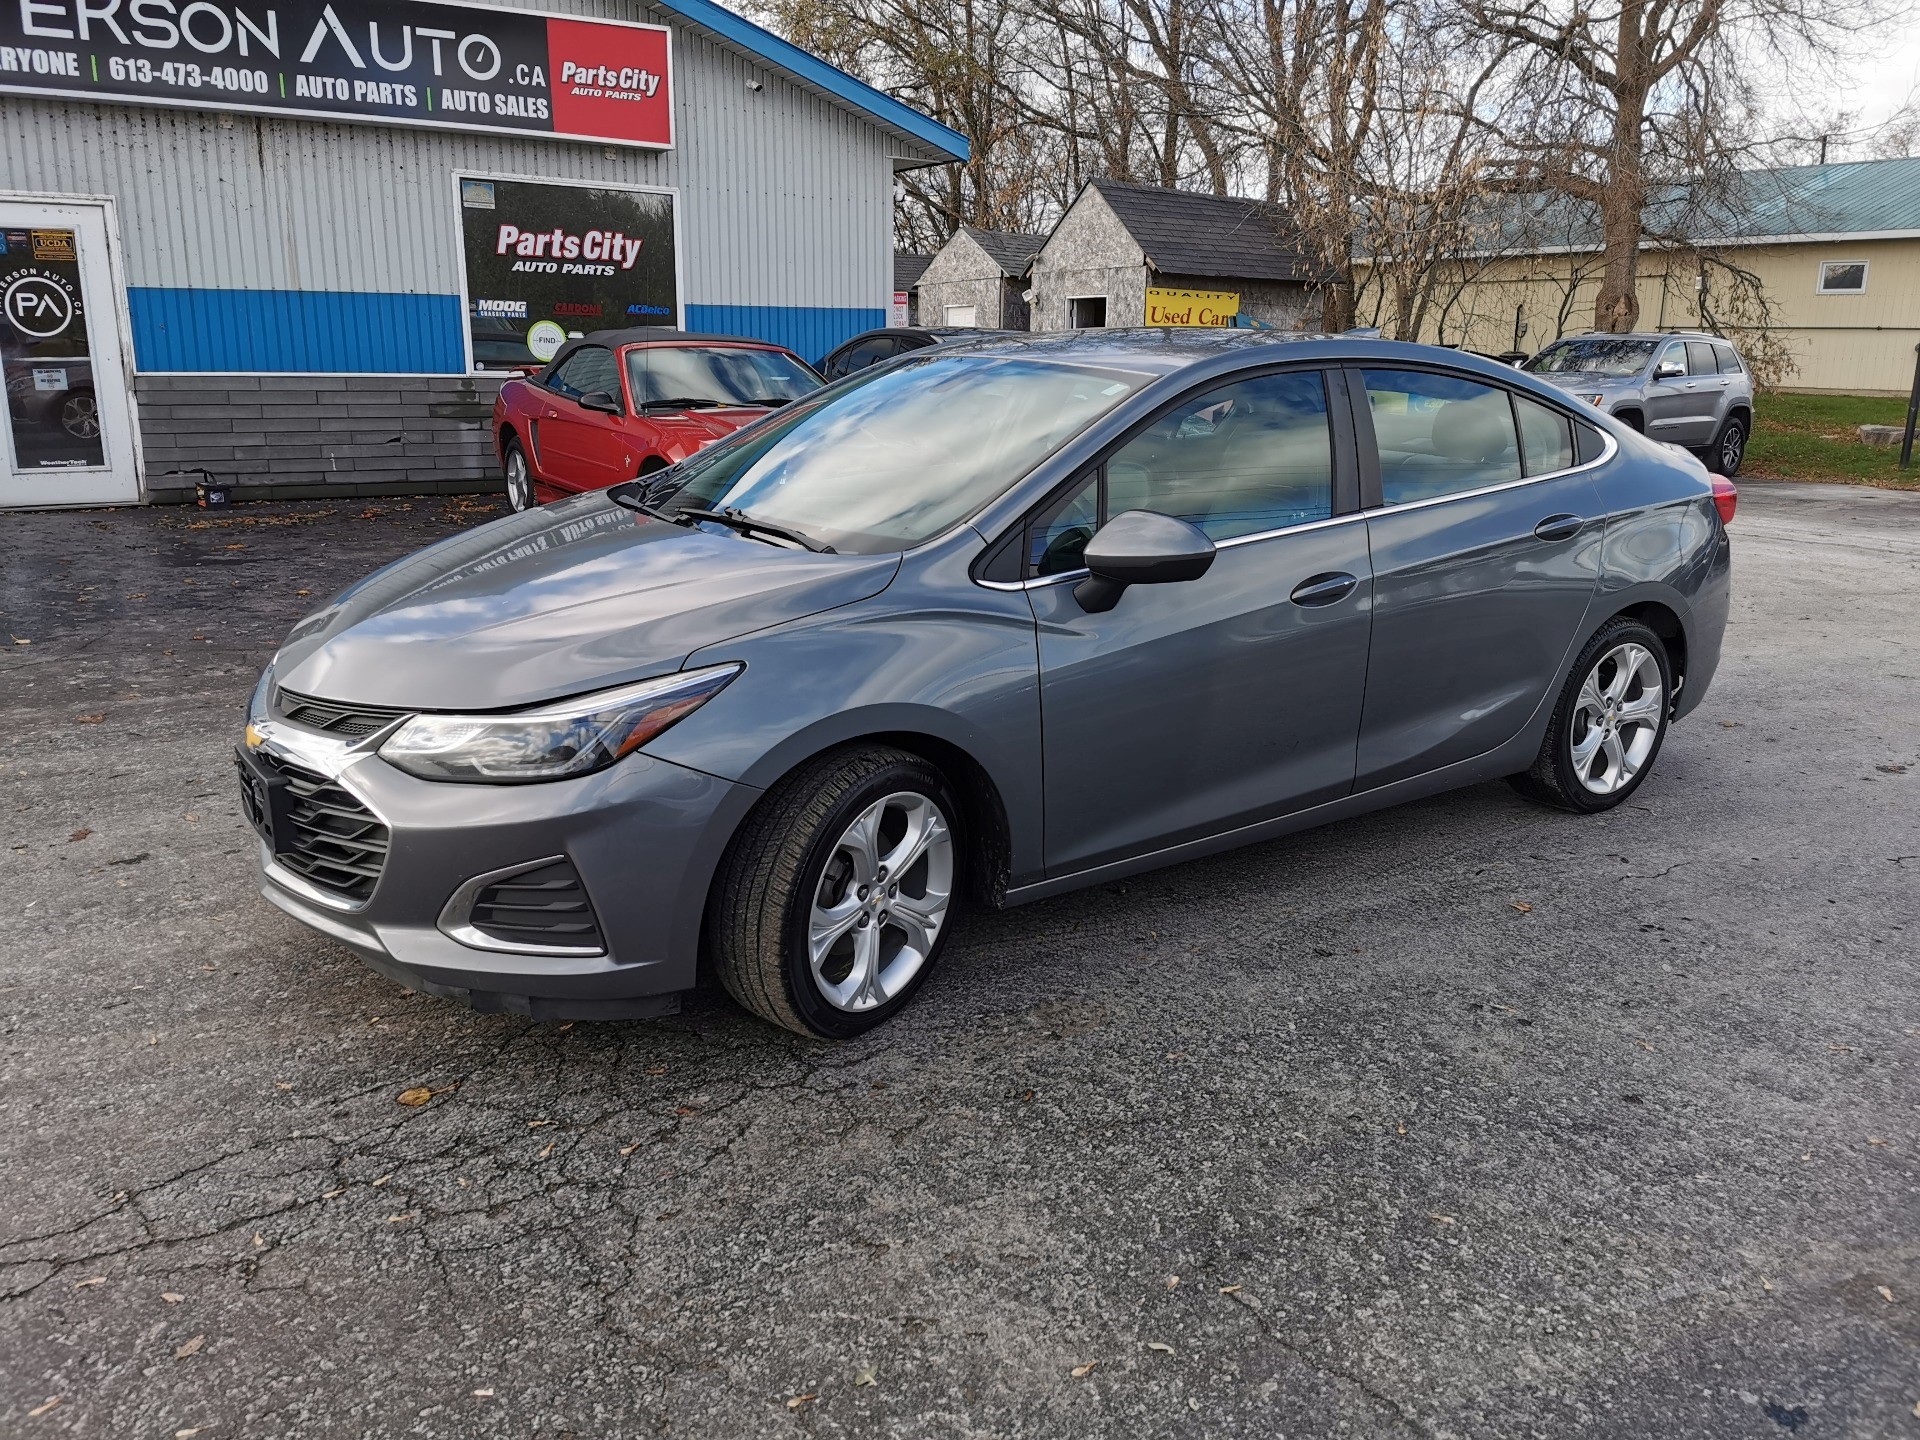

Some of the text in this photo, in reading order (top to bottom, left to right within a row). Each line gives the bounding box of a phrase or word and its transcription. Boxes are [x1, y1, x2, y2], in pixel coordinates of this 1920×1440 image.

[20, 0, 281, 60] ERSON
[0, 46, 269, 94] RYONE 613-473-4000
[295, 74, 418, 107] AUTO PARTS
[571, 87, 641, 101] AUTO PARTS
[441, 88, 549, 120] AUTO SALES
[40, 239, 69, 248] UCDA
[512, 261, 615, 276] AUTO PARTS
[1149, 290, 1235, 300] QUALITY
[16, 293, 63, 317] PA
[479, 300, 527, 312] MOOG
[1151, 306, 1192, 324] Used
